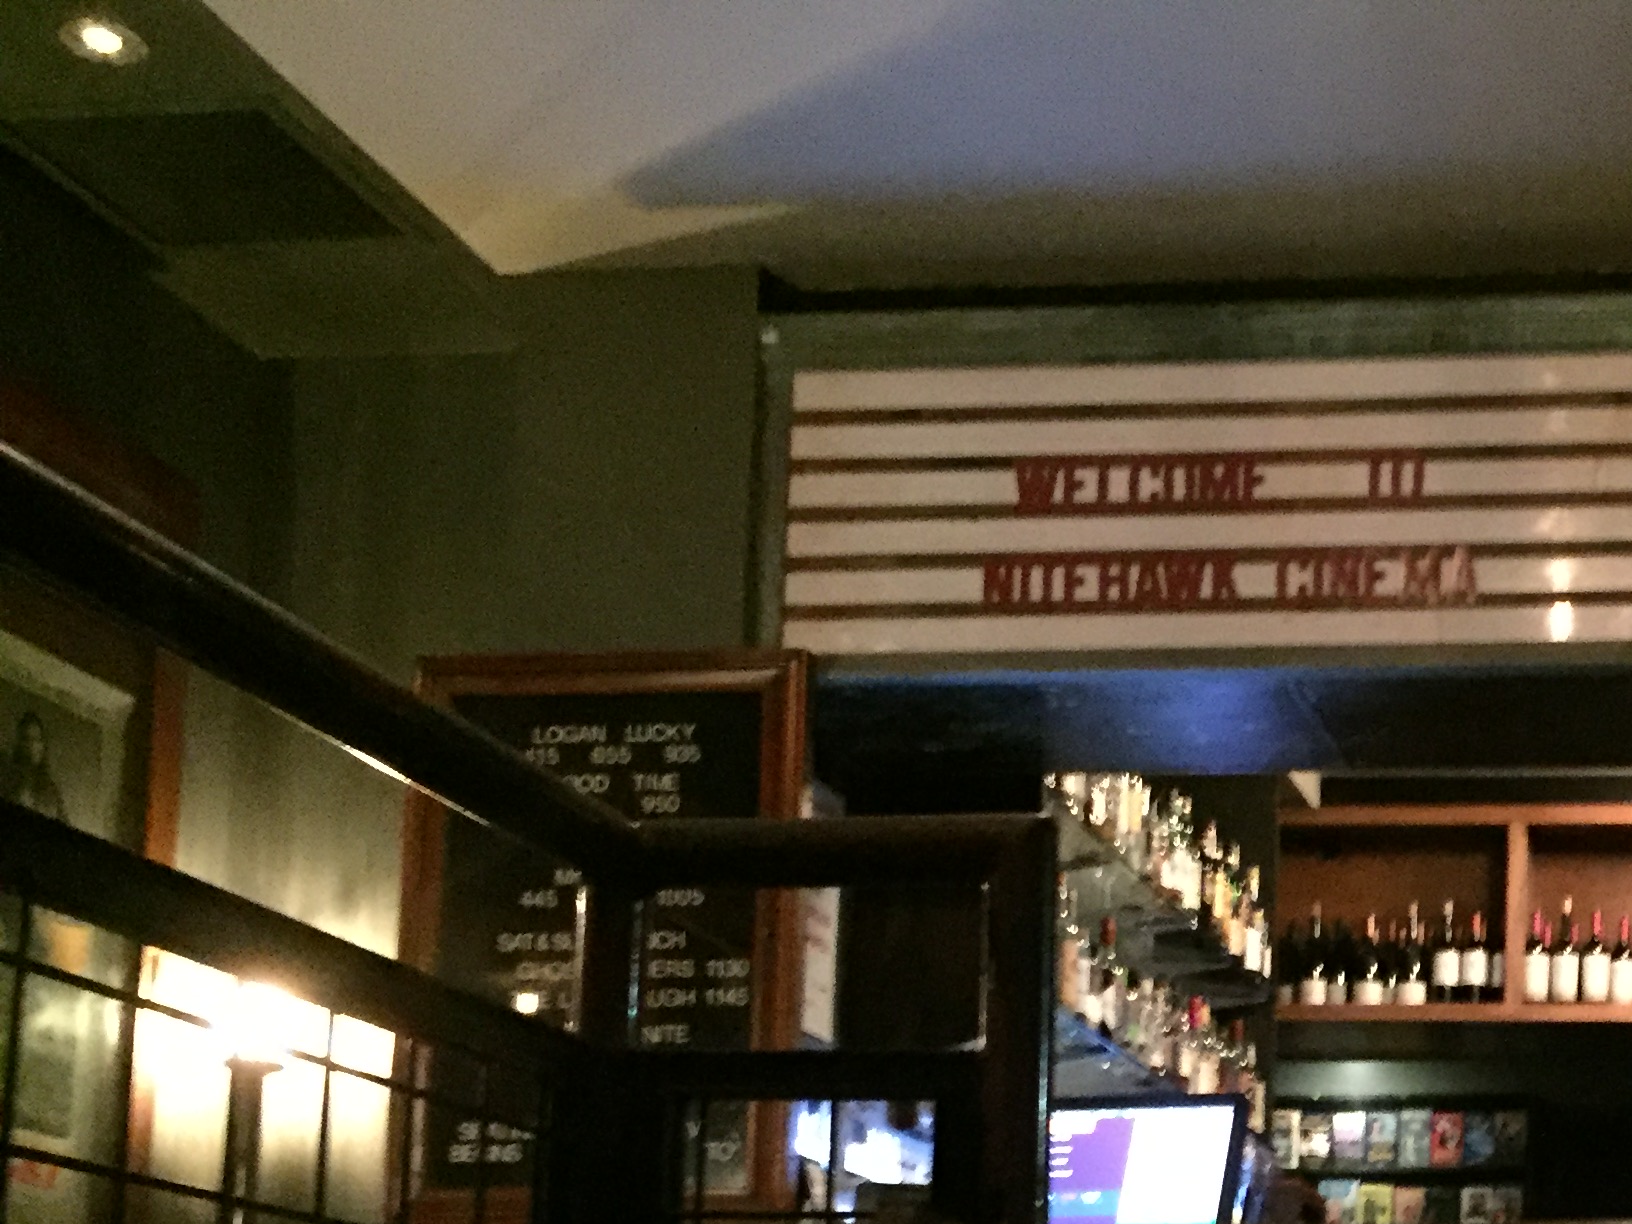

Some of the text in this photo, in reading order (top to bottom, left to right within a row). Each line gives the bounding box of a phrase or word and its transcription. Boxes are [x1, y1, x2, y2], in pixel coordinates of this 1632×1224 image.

[1014, 454, 1268, 512] WELCOME
[983, 546, 1477, 611] NITEHAWK CINEMA
[530, 722, 696, 744] LOGAN LUCKY
